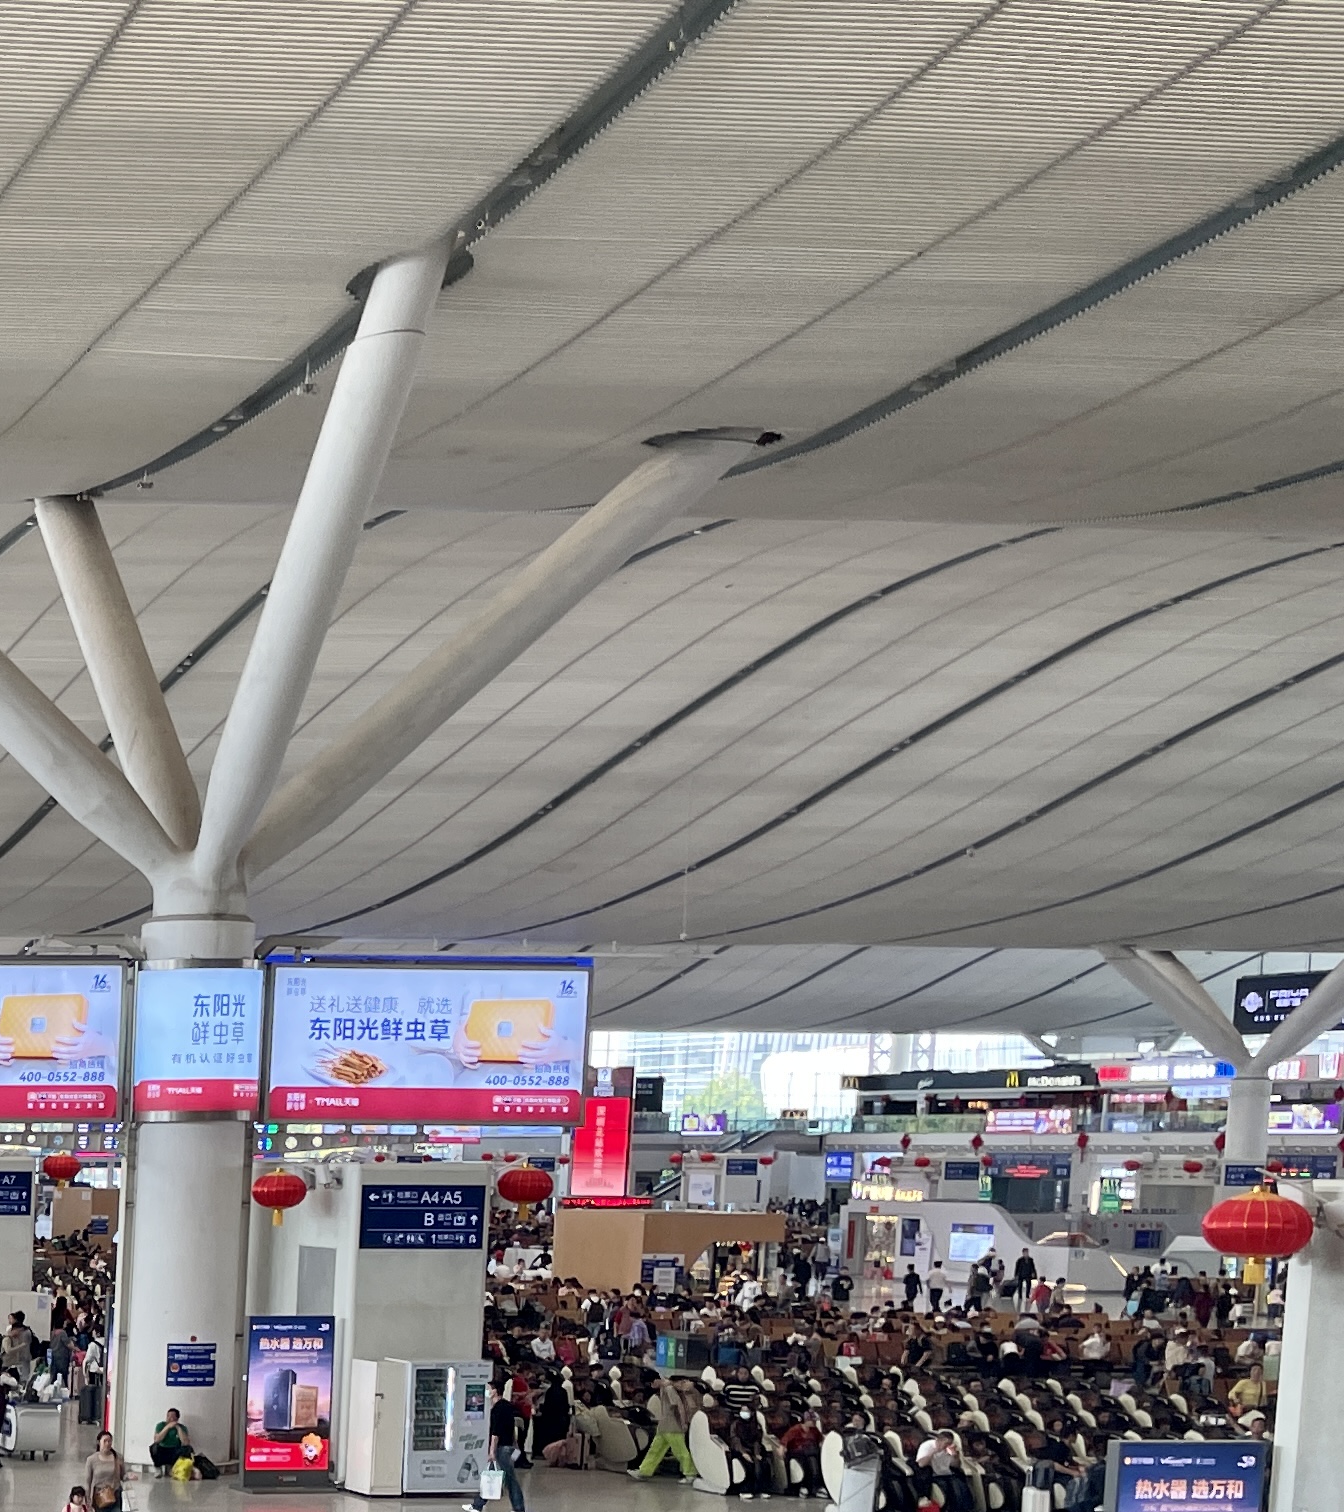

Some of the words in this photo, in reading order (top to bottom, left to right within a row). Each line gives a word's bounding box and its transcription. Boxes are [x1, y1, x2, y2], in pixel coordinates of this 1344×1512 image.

[193, 993, 246, 1018] 东阳光
[192, 1021, 245, 1046] 鲜虫草
[308, 1018, 452, 1042] 东阳光鲜虫草
[19, 1071, 106, 1082] 400-0552-888
[484, 1075, 570, 1087] 400-0552-888
[1028, 1074, 1082, 1087] McDonald's
[424, 1213, 435, 1226] B
[1134, 1479, 1188, 1500] 热水器
[1191, 1479, 1244, 1499] 选万和
